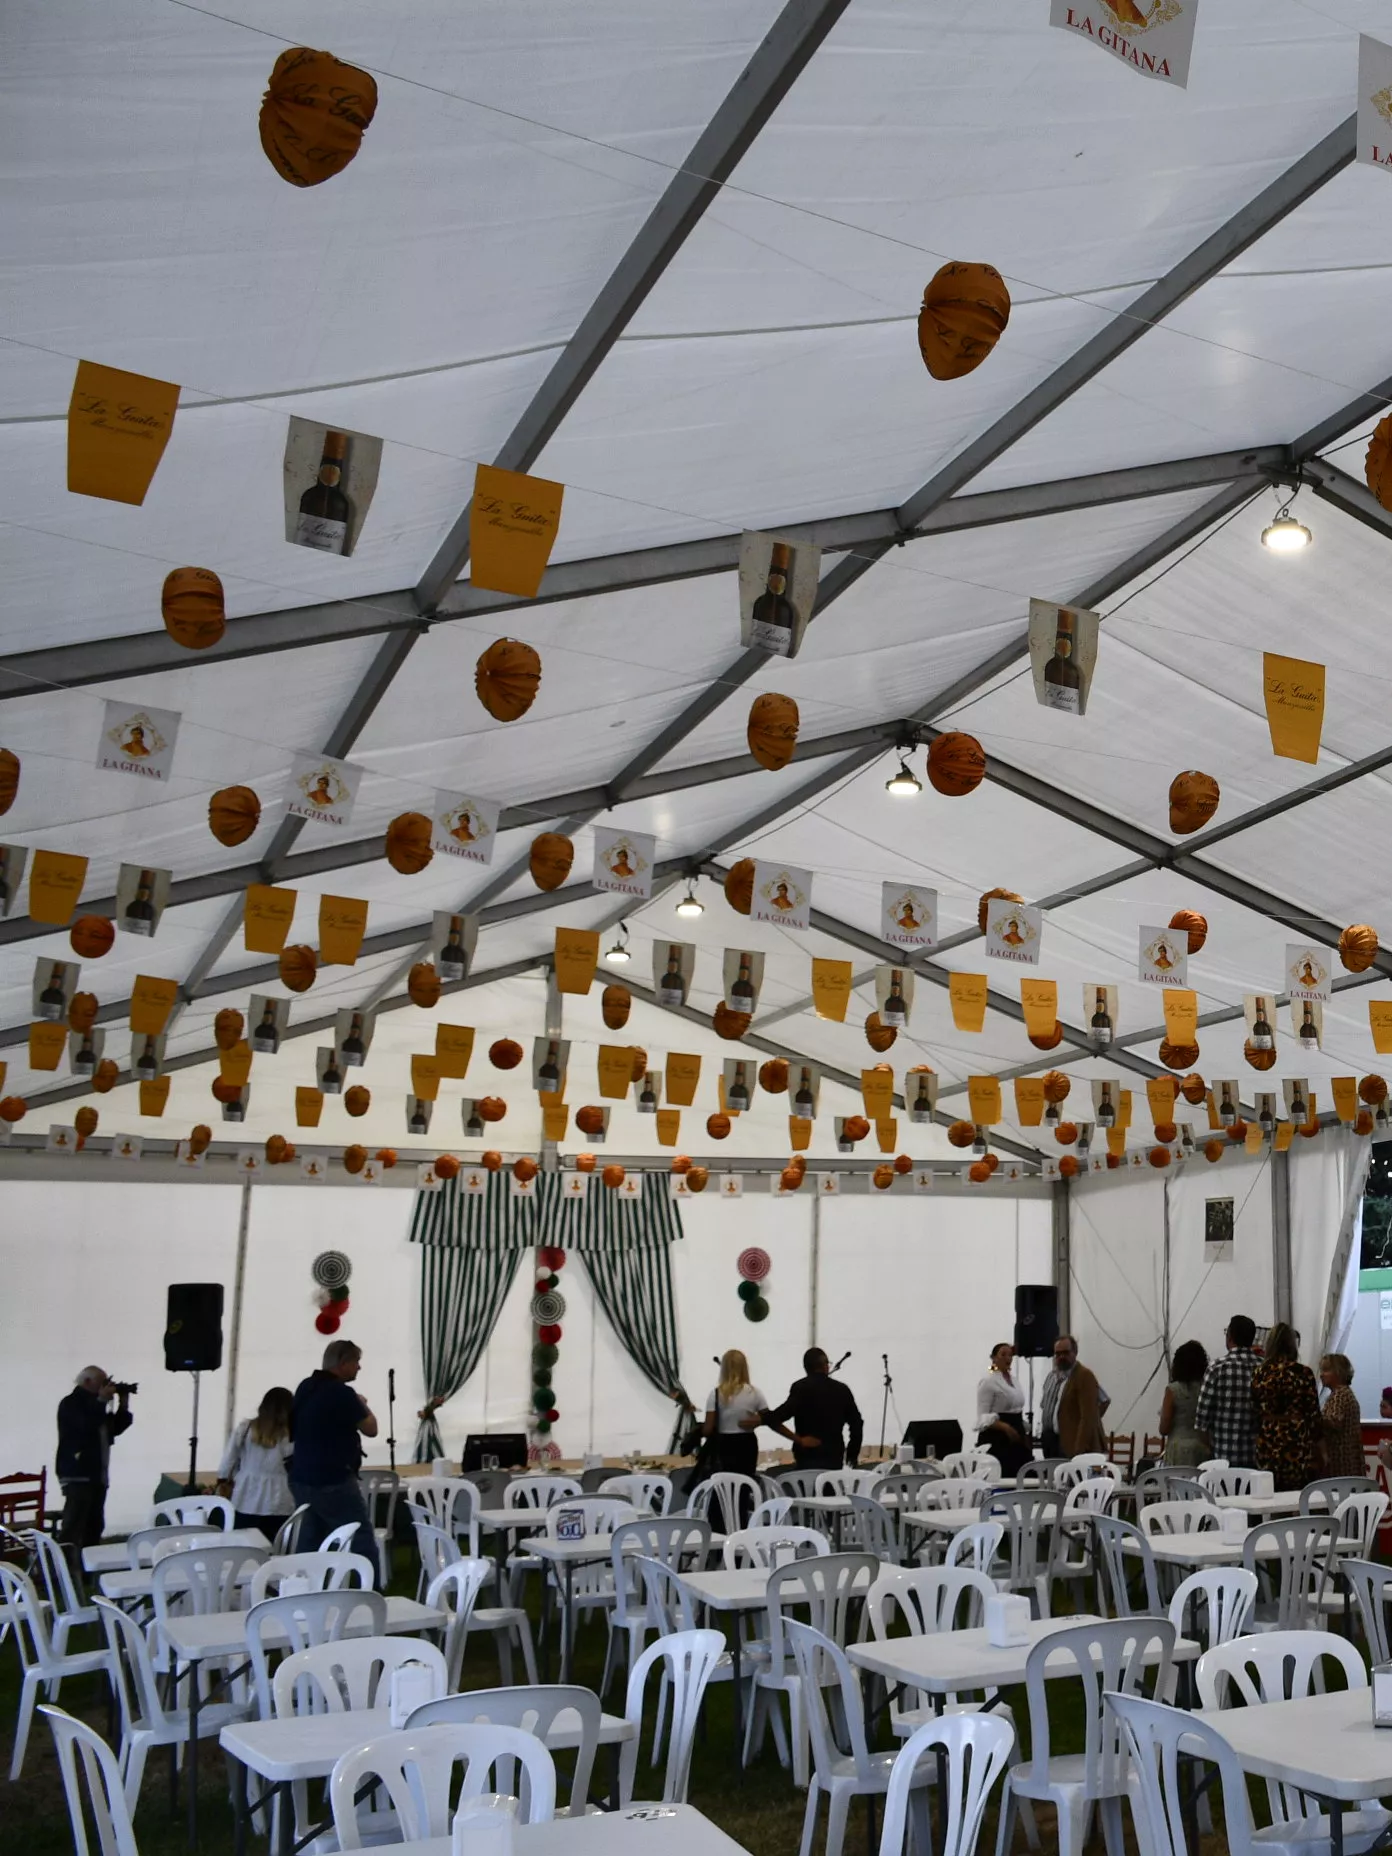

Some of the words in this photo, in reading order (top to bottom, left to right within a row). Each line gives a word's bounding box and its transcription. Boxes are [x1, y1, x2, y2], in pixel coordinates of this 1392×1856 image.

[1066, 8, 1094, 36] LA
[1097, 25, 1172, 77] GITANA
[102, 758, 119, 771] LA
[119, 761, 163, 779] GITANA
[288, 802, 305, 817] LA
[304, 806, 345, 826] GITANA
[435, 840, 451, 854] LA
[450, 844, 486, 863] GITANA
[597, 879, 613, 891] LA
[613, 882, 646, 897] GITANA
[757, 911, 771, 921] LA
[772, 913, 804, 929] GITANA
[885, 932, 897, 943] LA
[898, 935, 933, 946] GITANA
[989, 948, 1002, 958] LA
[1002, 951, 1034, 963] GITANA
[1143, 973, 1154, 983] LA
[1155, 974, 1183, 986] GITANA
[1290, 990, 1300, 999] LA
[1300, 991, 1328, 1001] GITANA
